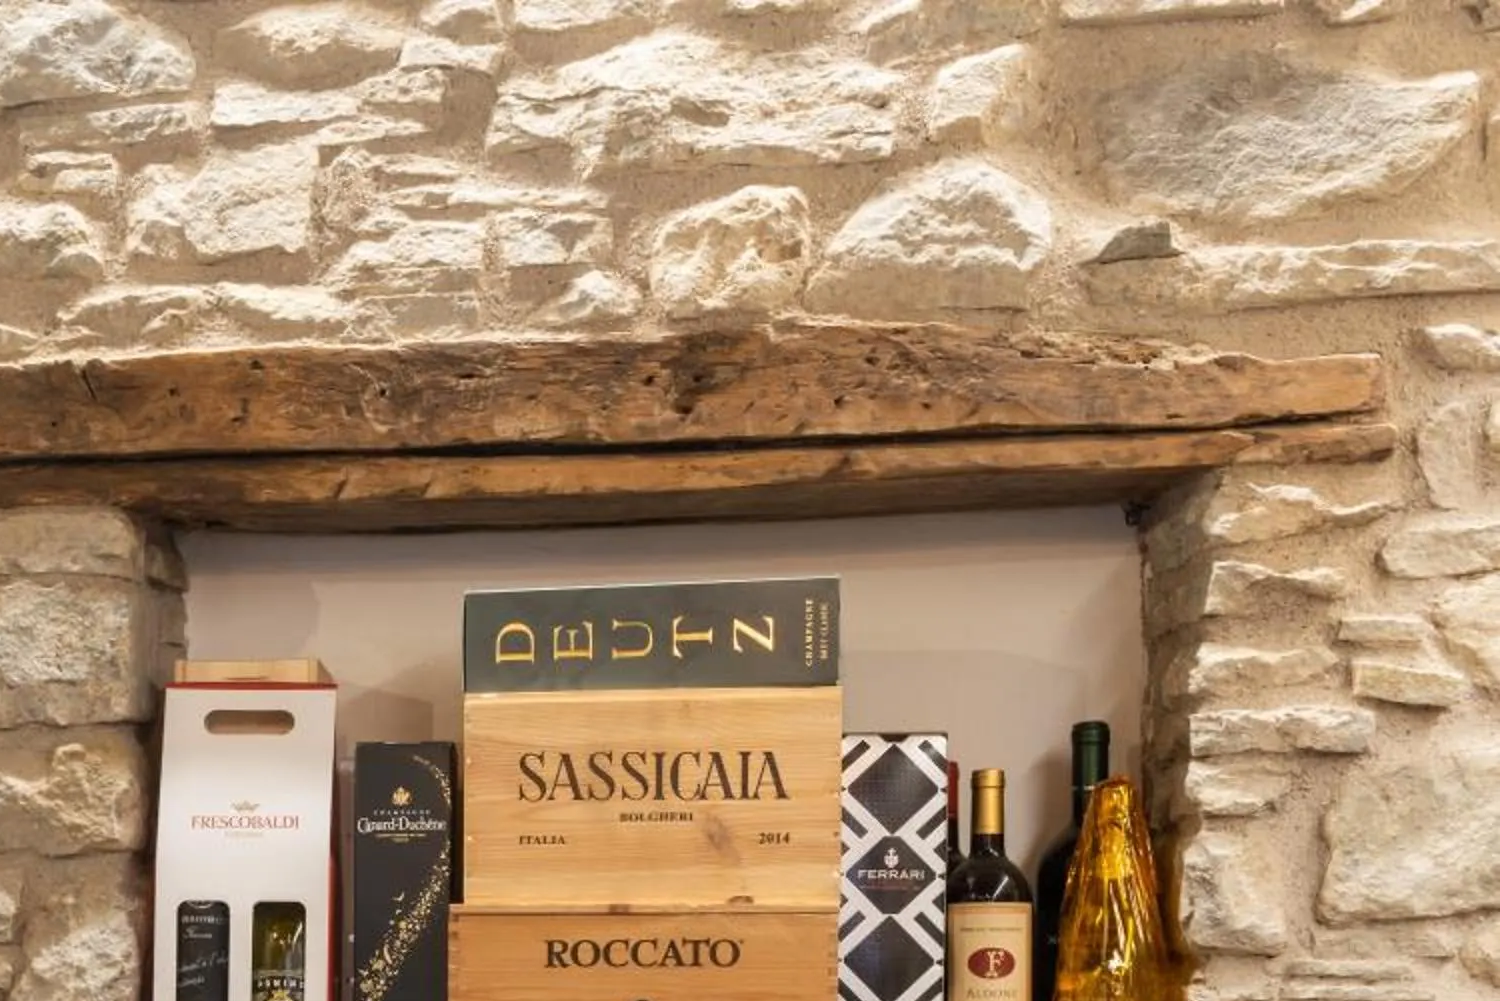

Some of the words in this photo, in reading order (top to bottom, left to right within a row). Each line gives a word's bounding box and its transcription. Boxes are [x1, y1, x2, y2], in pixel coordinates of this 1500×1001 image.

[494, 614, 775, 664] DEUTZ
[518, 751, 790, 802] SASSICAIA
[190, 815, 300, 830] FRESCOBALDI
[619, 811, 694, 823] BOLGHERI
[518, 835, 566, 846] ITALIA
[758, 832, 791, 845] 2014
[857, 869, 926, 880] FERRARI
[544, 938, 742, 969] ROCCATO
